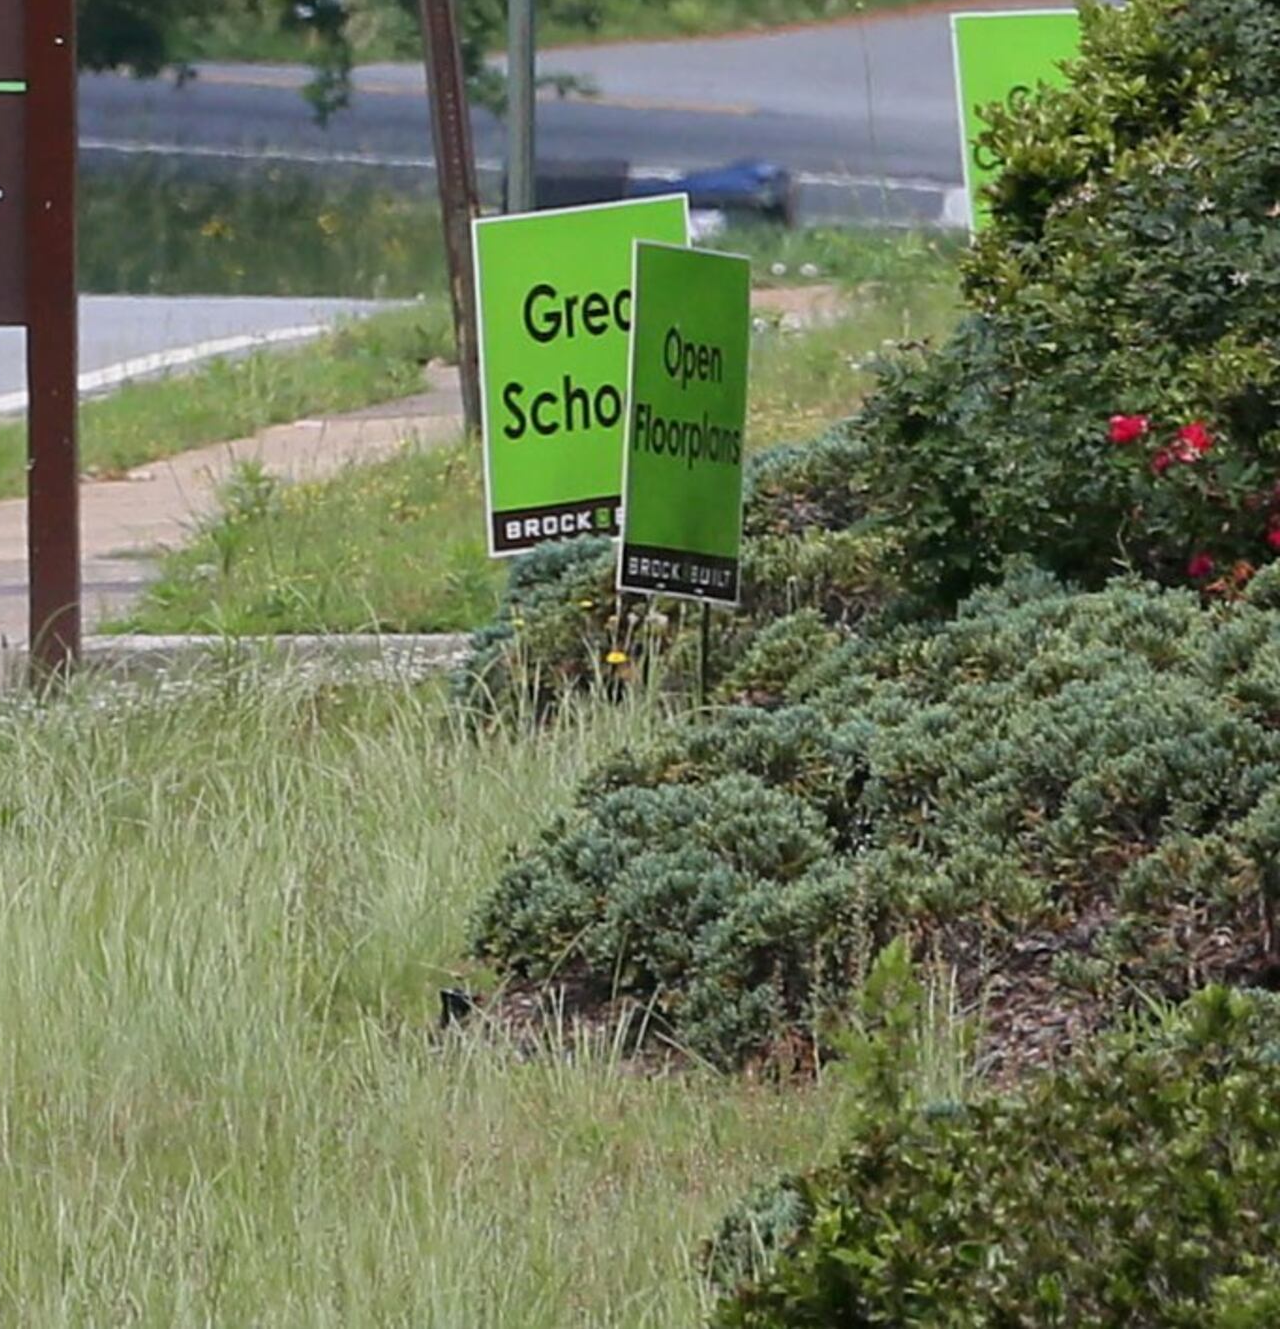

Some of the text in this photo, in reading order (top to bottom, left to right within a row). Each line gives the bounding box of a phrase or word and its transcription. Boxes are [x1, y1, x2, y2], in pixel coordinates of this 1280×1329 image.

[663, 326, 722, 390] Open
[502, 374, 628, 440] Scho
[634, 402, 742, 470] Floorplans
[505, 510, 593, 541] BROCK
[628, 556, 681, 581] BROCK
